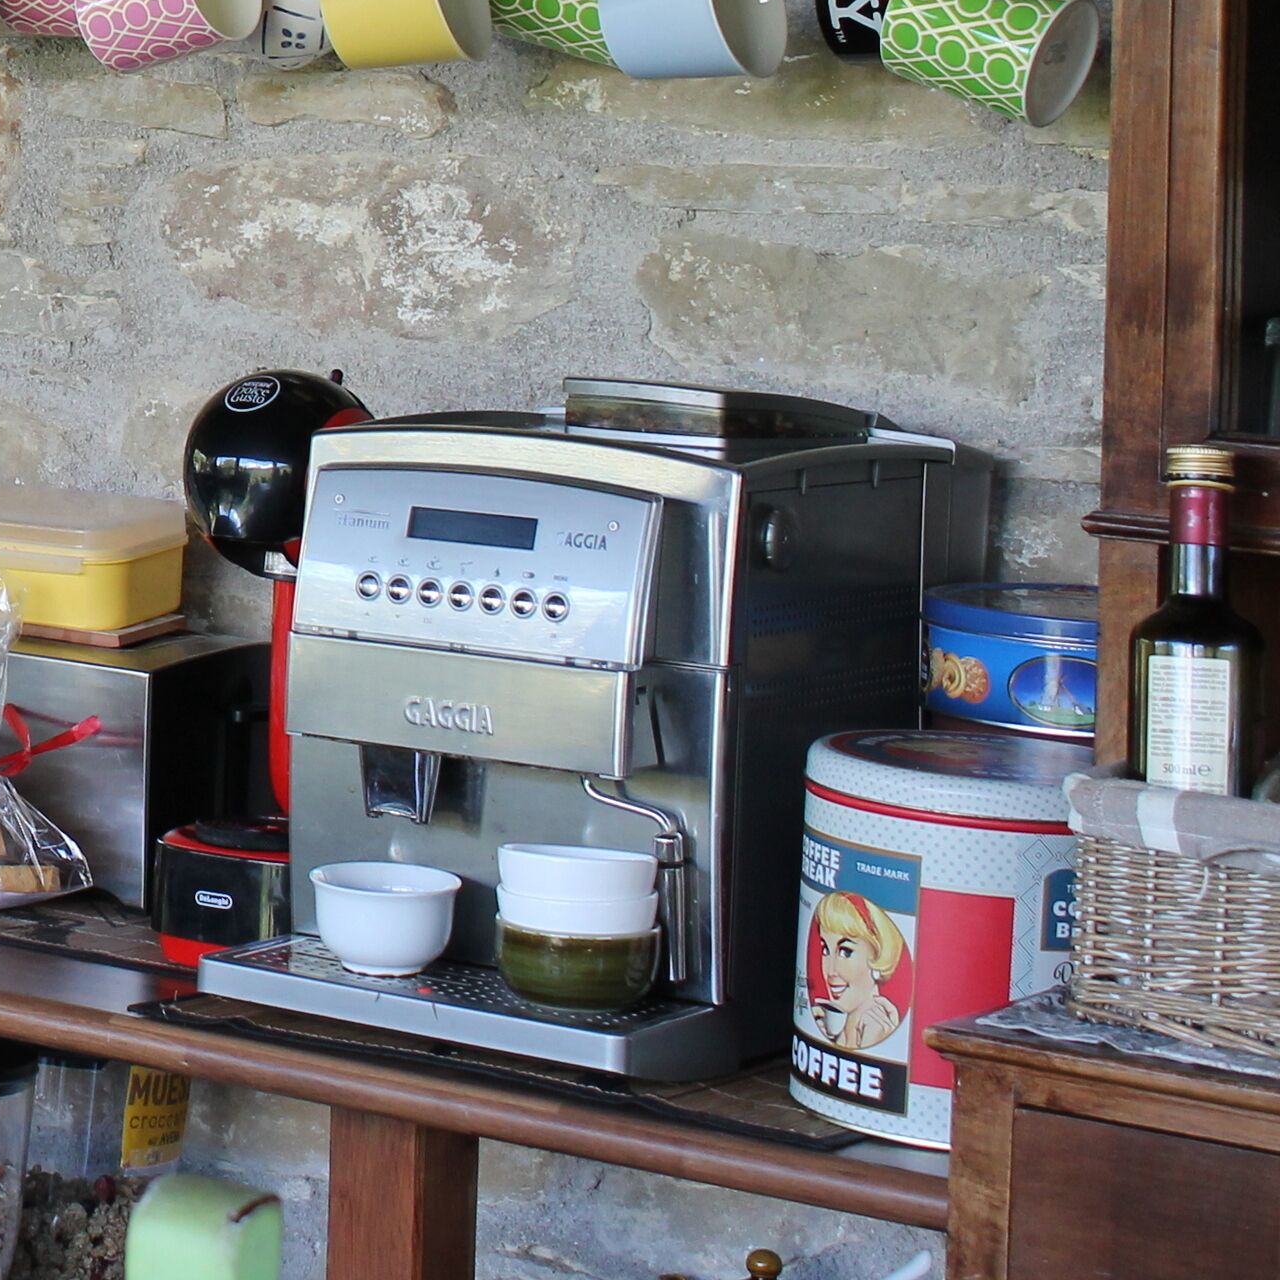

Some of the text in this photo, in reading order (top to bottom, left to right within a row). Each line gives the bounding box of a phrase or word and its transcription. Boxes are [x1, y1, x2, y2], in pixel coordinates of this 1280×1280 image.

[557, 531, 608, 551] AGGIA
[404, 696, 494, 736] GAGGIA
[803, 833, 840, 870] OFFEE
[856, 862, 910, 881] TRADE MARK
